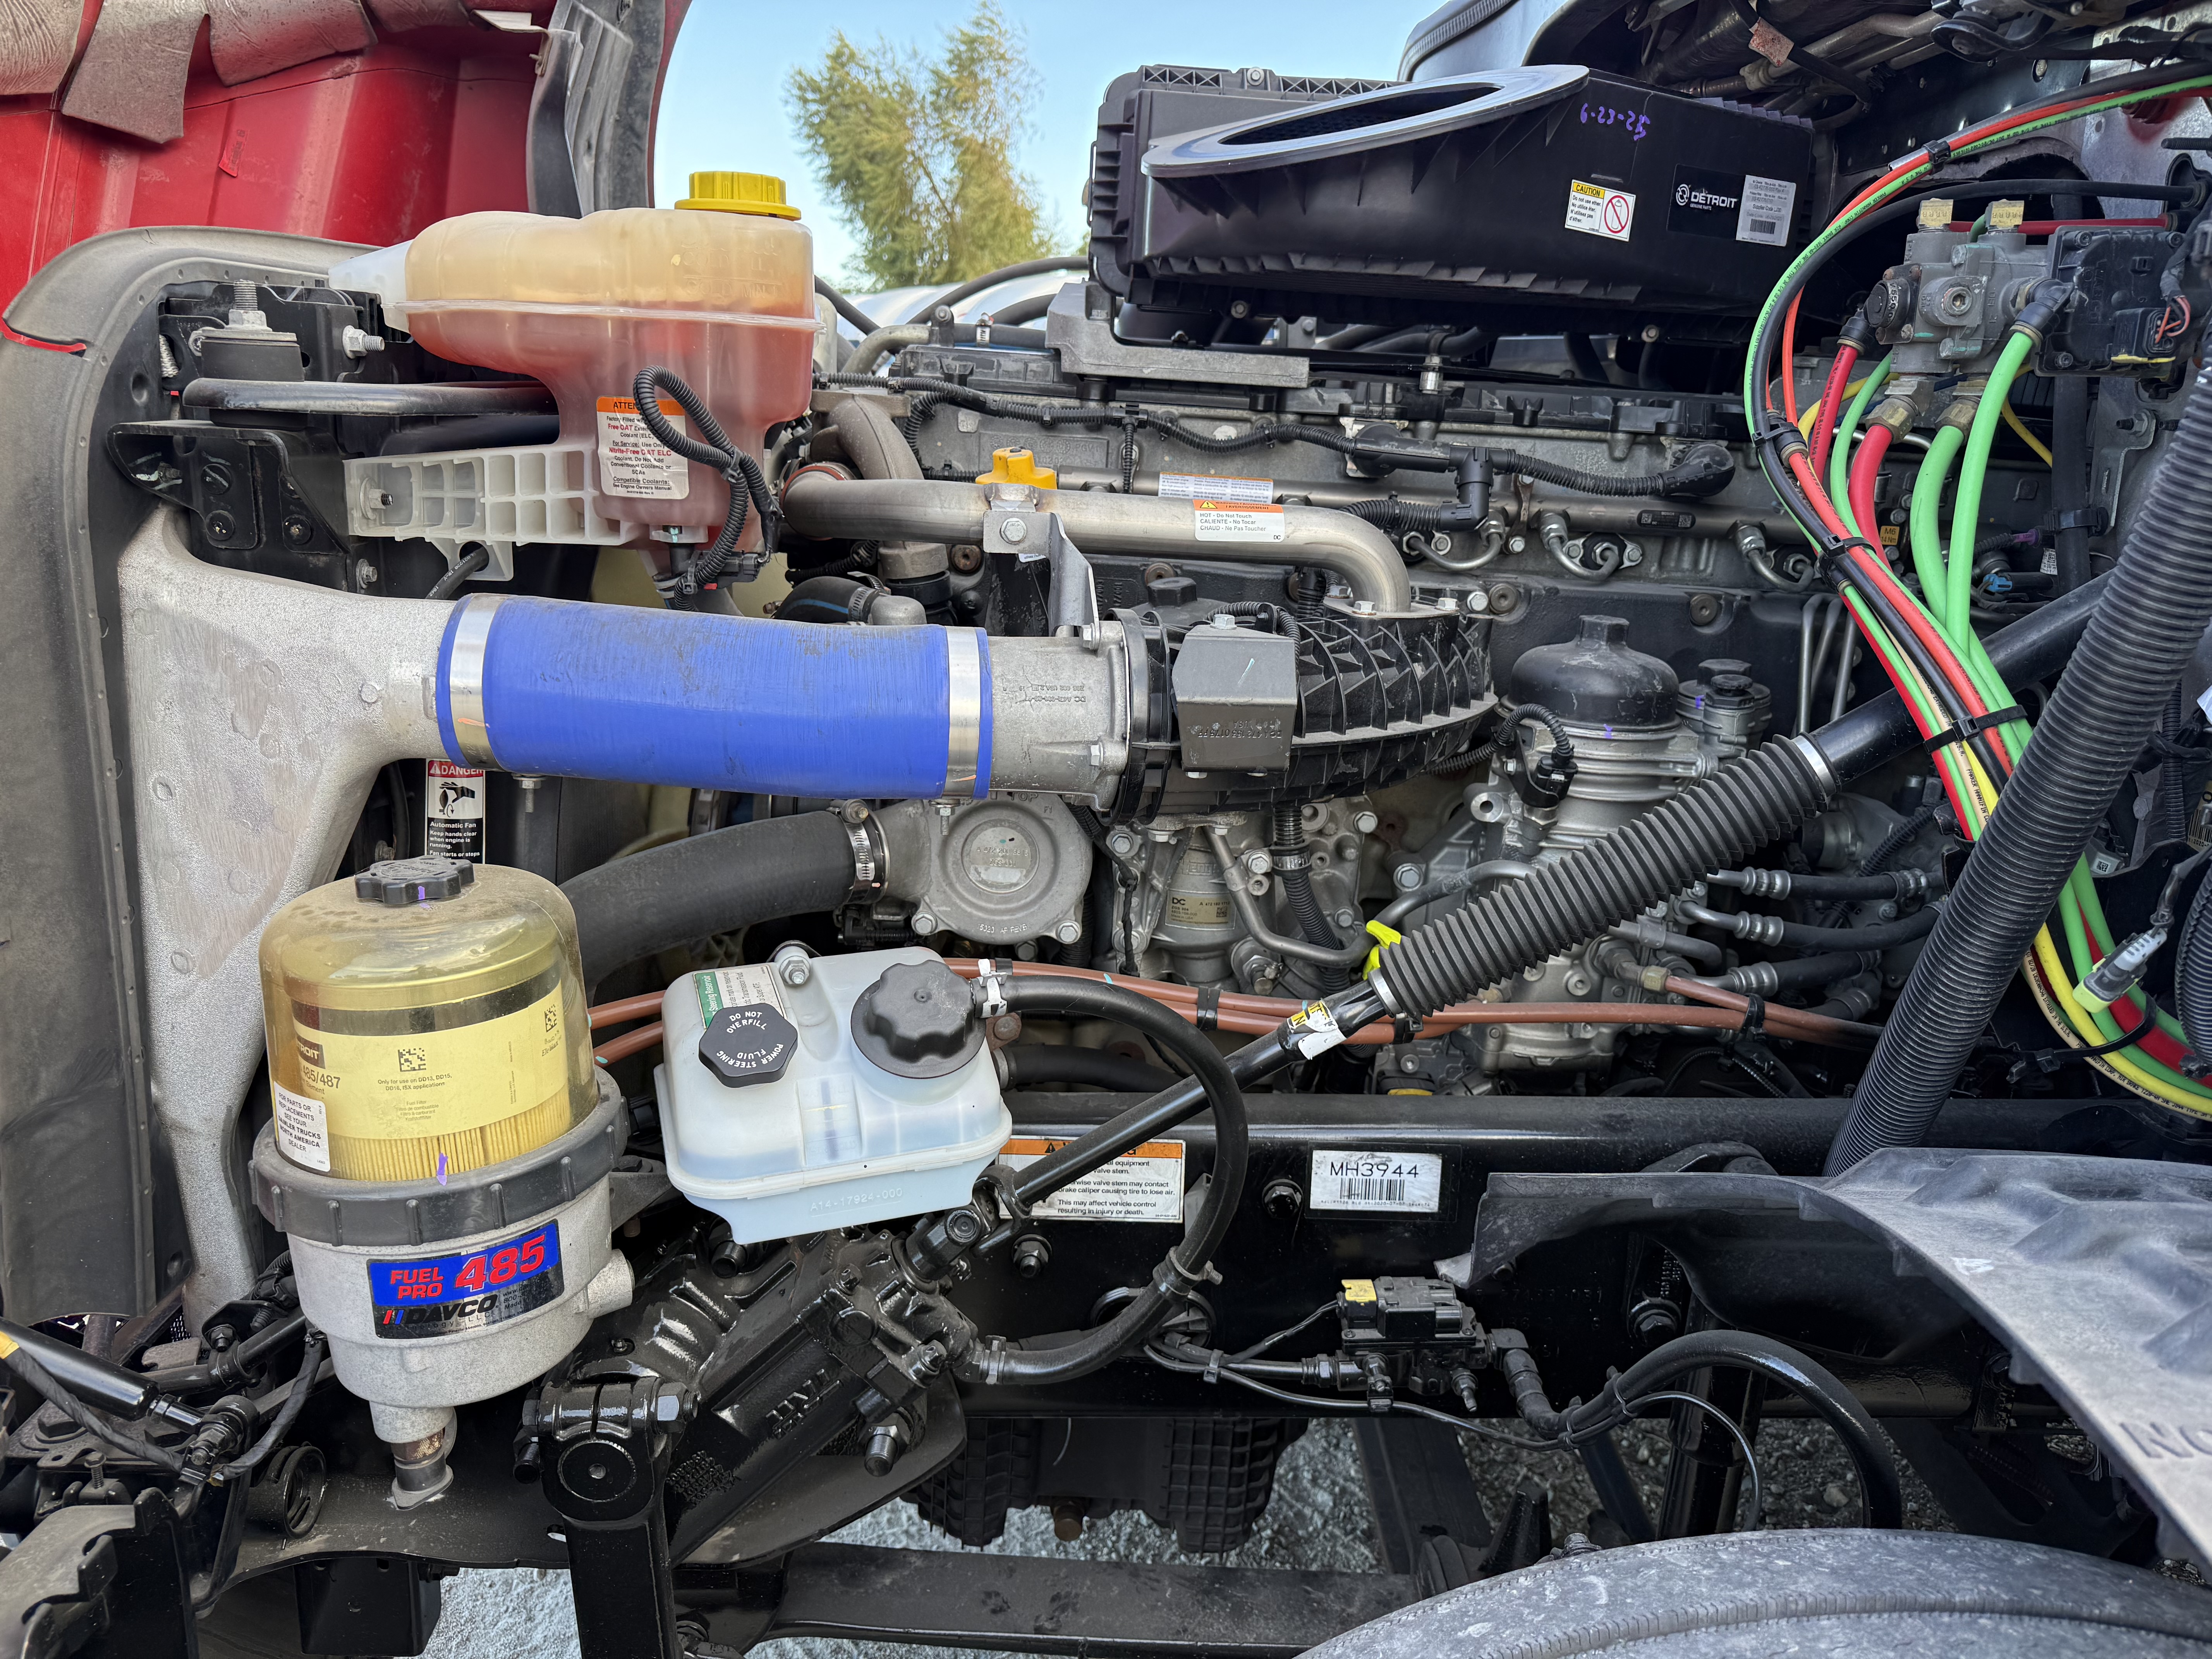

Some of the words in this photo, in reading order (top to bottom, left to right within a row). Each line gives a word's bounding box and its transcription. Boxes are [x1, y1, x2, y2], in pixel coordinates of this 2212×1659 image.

[1576, 185, 1601, 197] CAUTION
[1691, 192, 1737, 208] DETROIT
[1832, 223, 1842, 232] AIR
[609, 447, 639, 455] Nitrite-Free
[1930, 695, 1949, 720] EXTRUDED
[1966, 768, 1978, 788] PARKER
[1973, 788, 1988, 814] HANNIFIN
[1172, 897, 1186, 906] DC
[702, 974, 714, 994] Reservoir
[738, 979, 750, 1000] Transmission
[726, 988, 735, 997] mark
[706, 993, 720, 1012] Steering
[729, 1013, 741, 1022] DO
[2055, 1018, 2064, 1027] THE
[726, 1019, 768, 1034] OVERFILL
[716, 1050, 757, 1068] STEERING
[737, 1048, 767, 1060] FLUID
[761, 1043, 784, 1065] POWER
[413, 1082, 445, 1090] applications
[2116, 1073, 2127, 1083] AIR
[279, 1100, 314, 1121] REPLACEMENTS
[287, 1097, 302, 1109] PARTS
[278, 1115, 295, 1132] DAIMLER
[296, 1126, 321, 1140] TRUCKS
[284, 1112, 293, 1120] SEE
[292, 1116, 307, 1127] YOUR
[280, 1124, 293, 1138] NORTH
[294, 1134, 320, 1148] AMERICA
[288, 1138, 307, 1152] DEALER
[1330, 1161, 1419, 1178] MH3944
[810, 1188, 902, 1212] A14-17924-000
[390, 1267, 444, 1285] FUEL
[453, 1231, 546, 1292] 485
[397, 1282, 443, 1300] PRO
[404, 1293, 498, 1324] DAVCO
